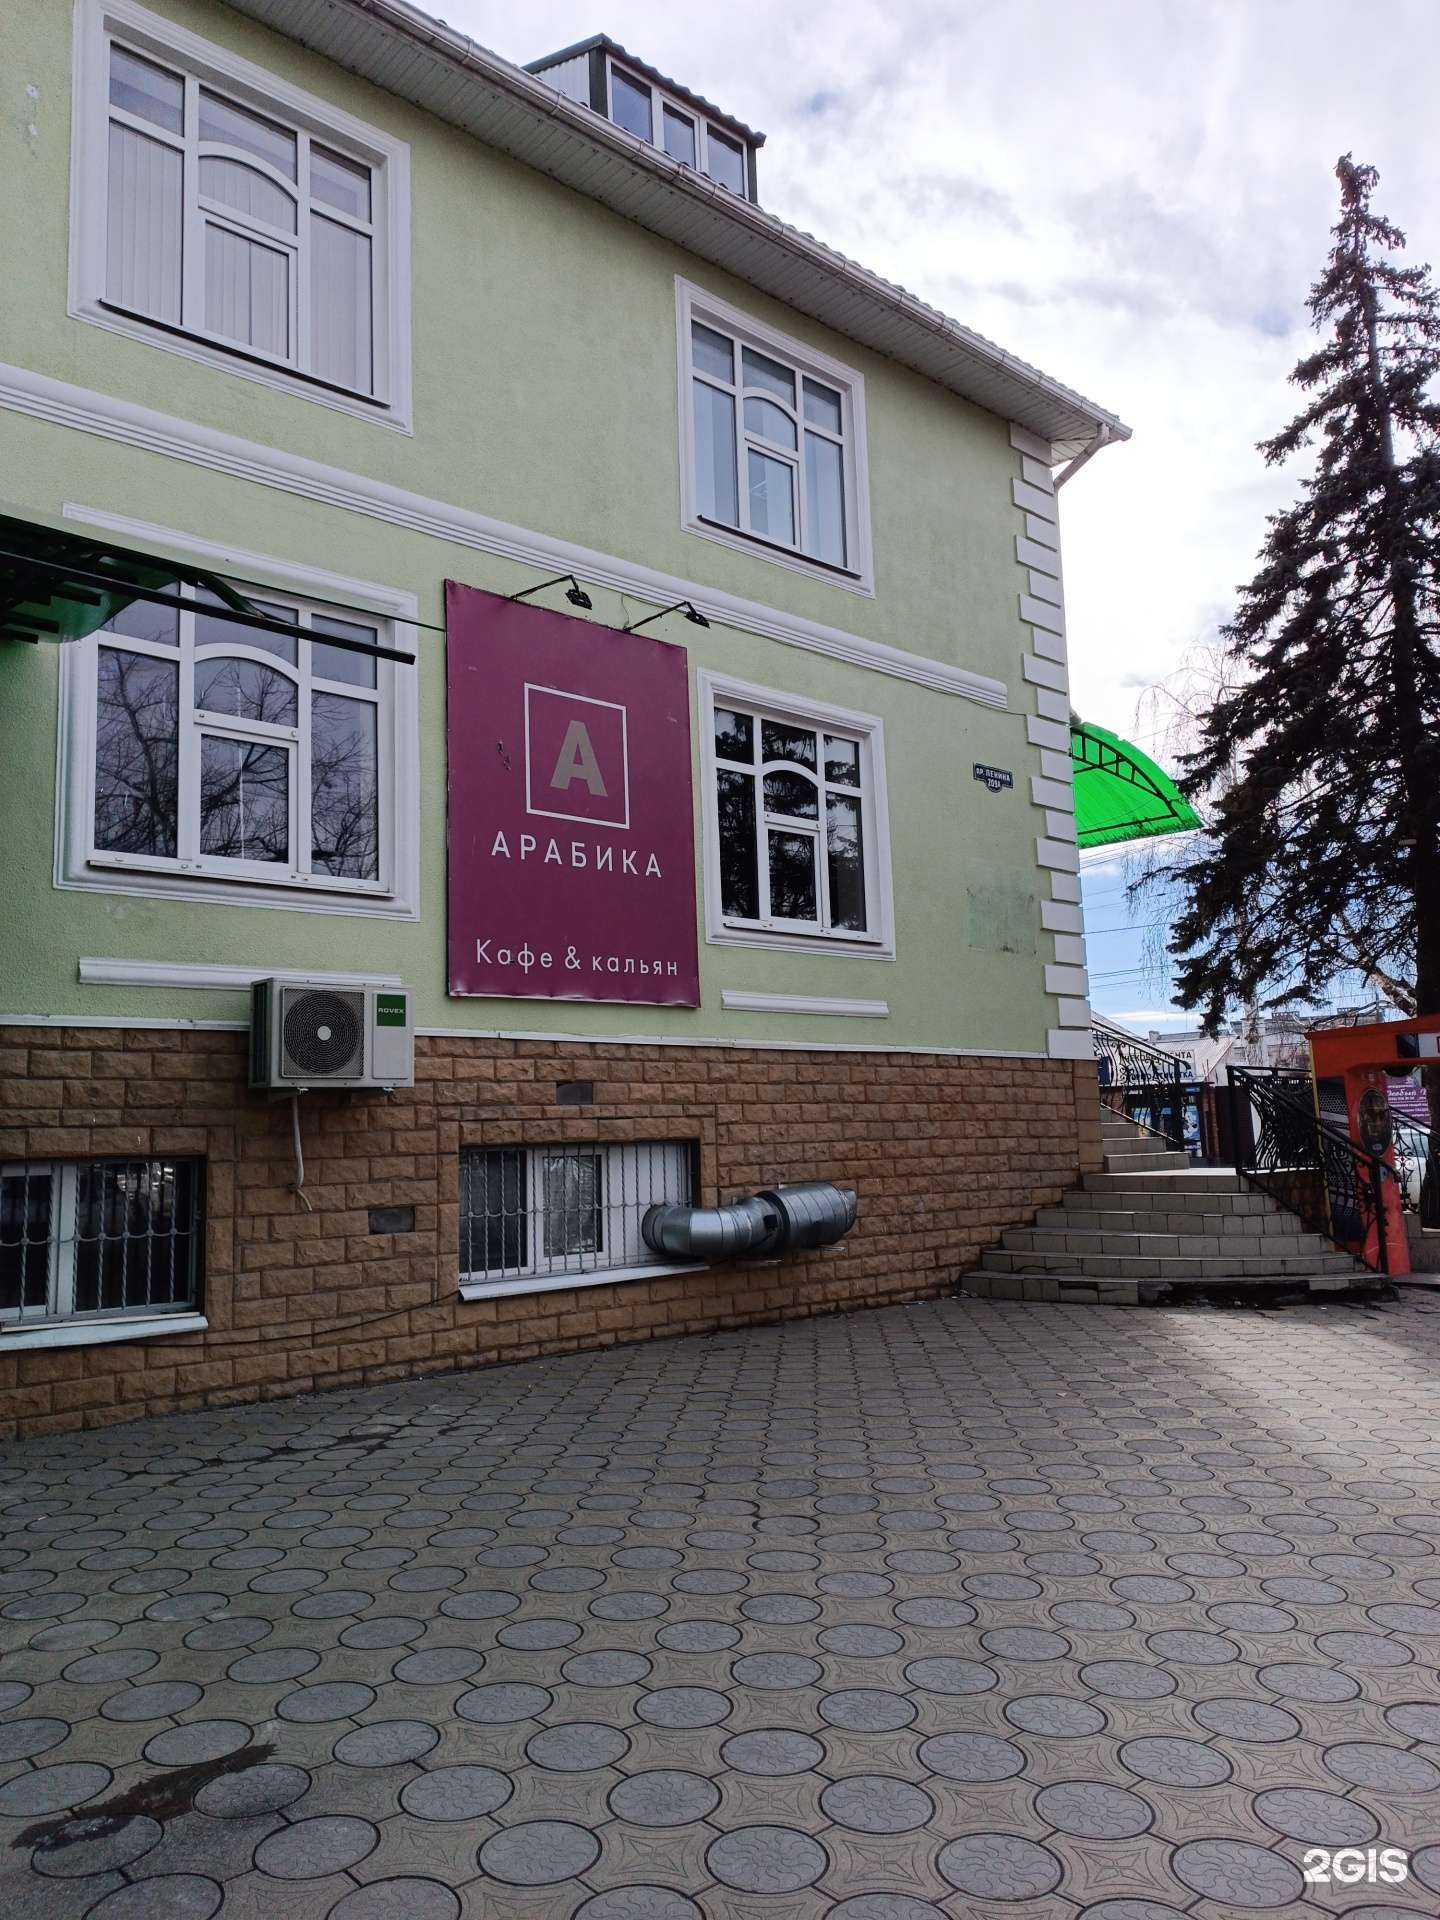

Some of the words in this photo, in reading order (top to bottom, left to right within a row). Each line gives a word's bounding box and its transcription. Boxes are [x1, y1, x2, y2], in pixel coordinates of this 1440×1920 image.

[550, 720, 608, 797] А
[491, 830, 663, 879] АРАБИКА
[476, 939, 553, 974] Кафе
[565, 946, 581, 970] &
[592, 953, 678, 976] кальян
